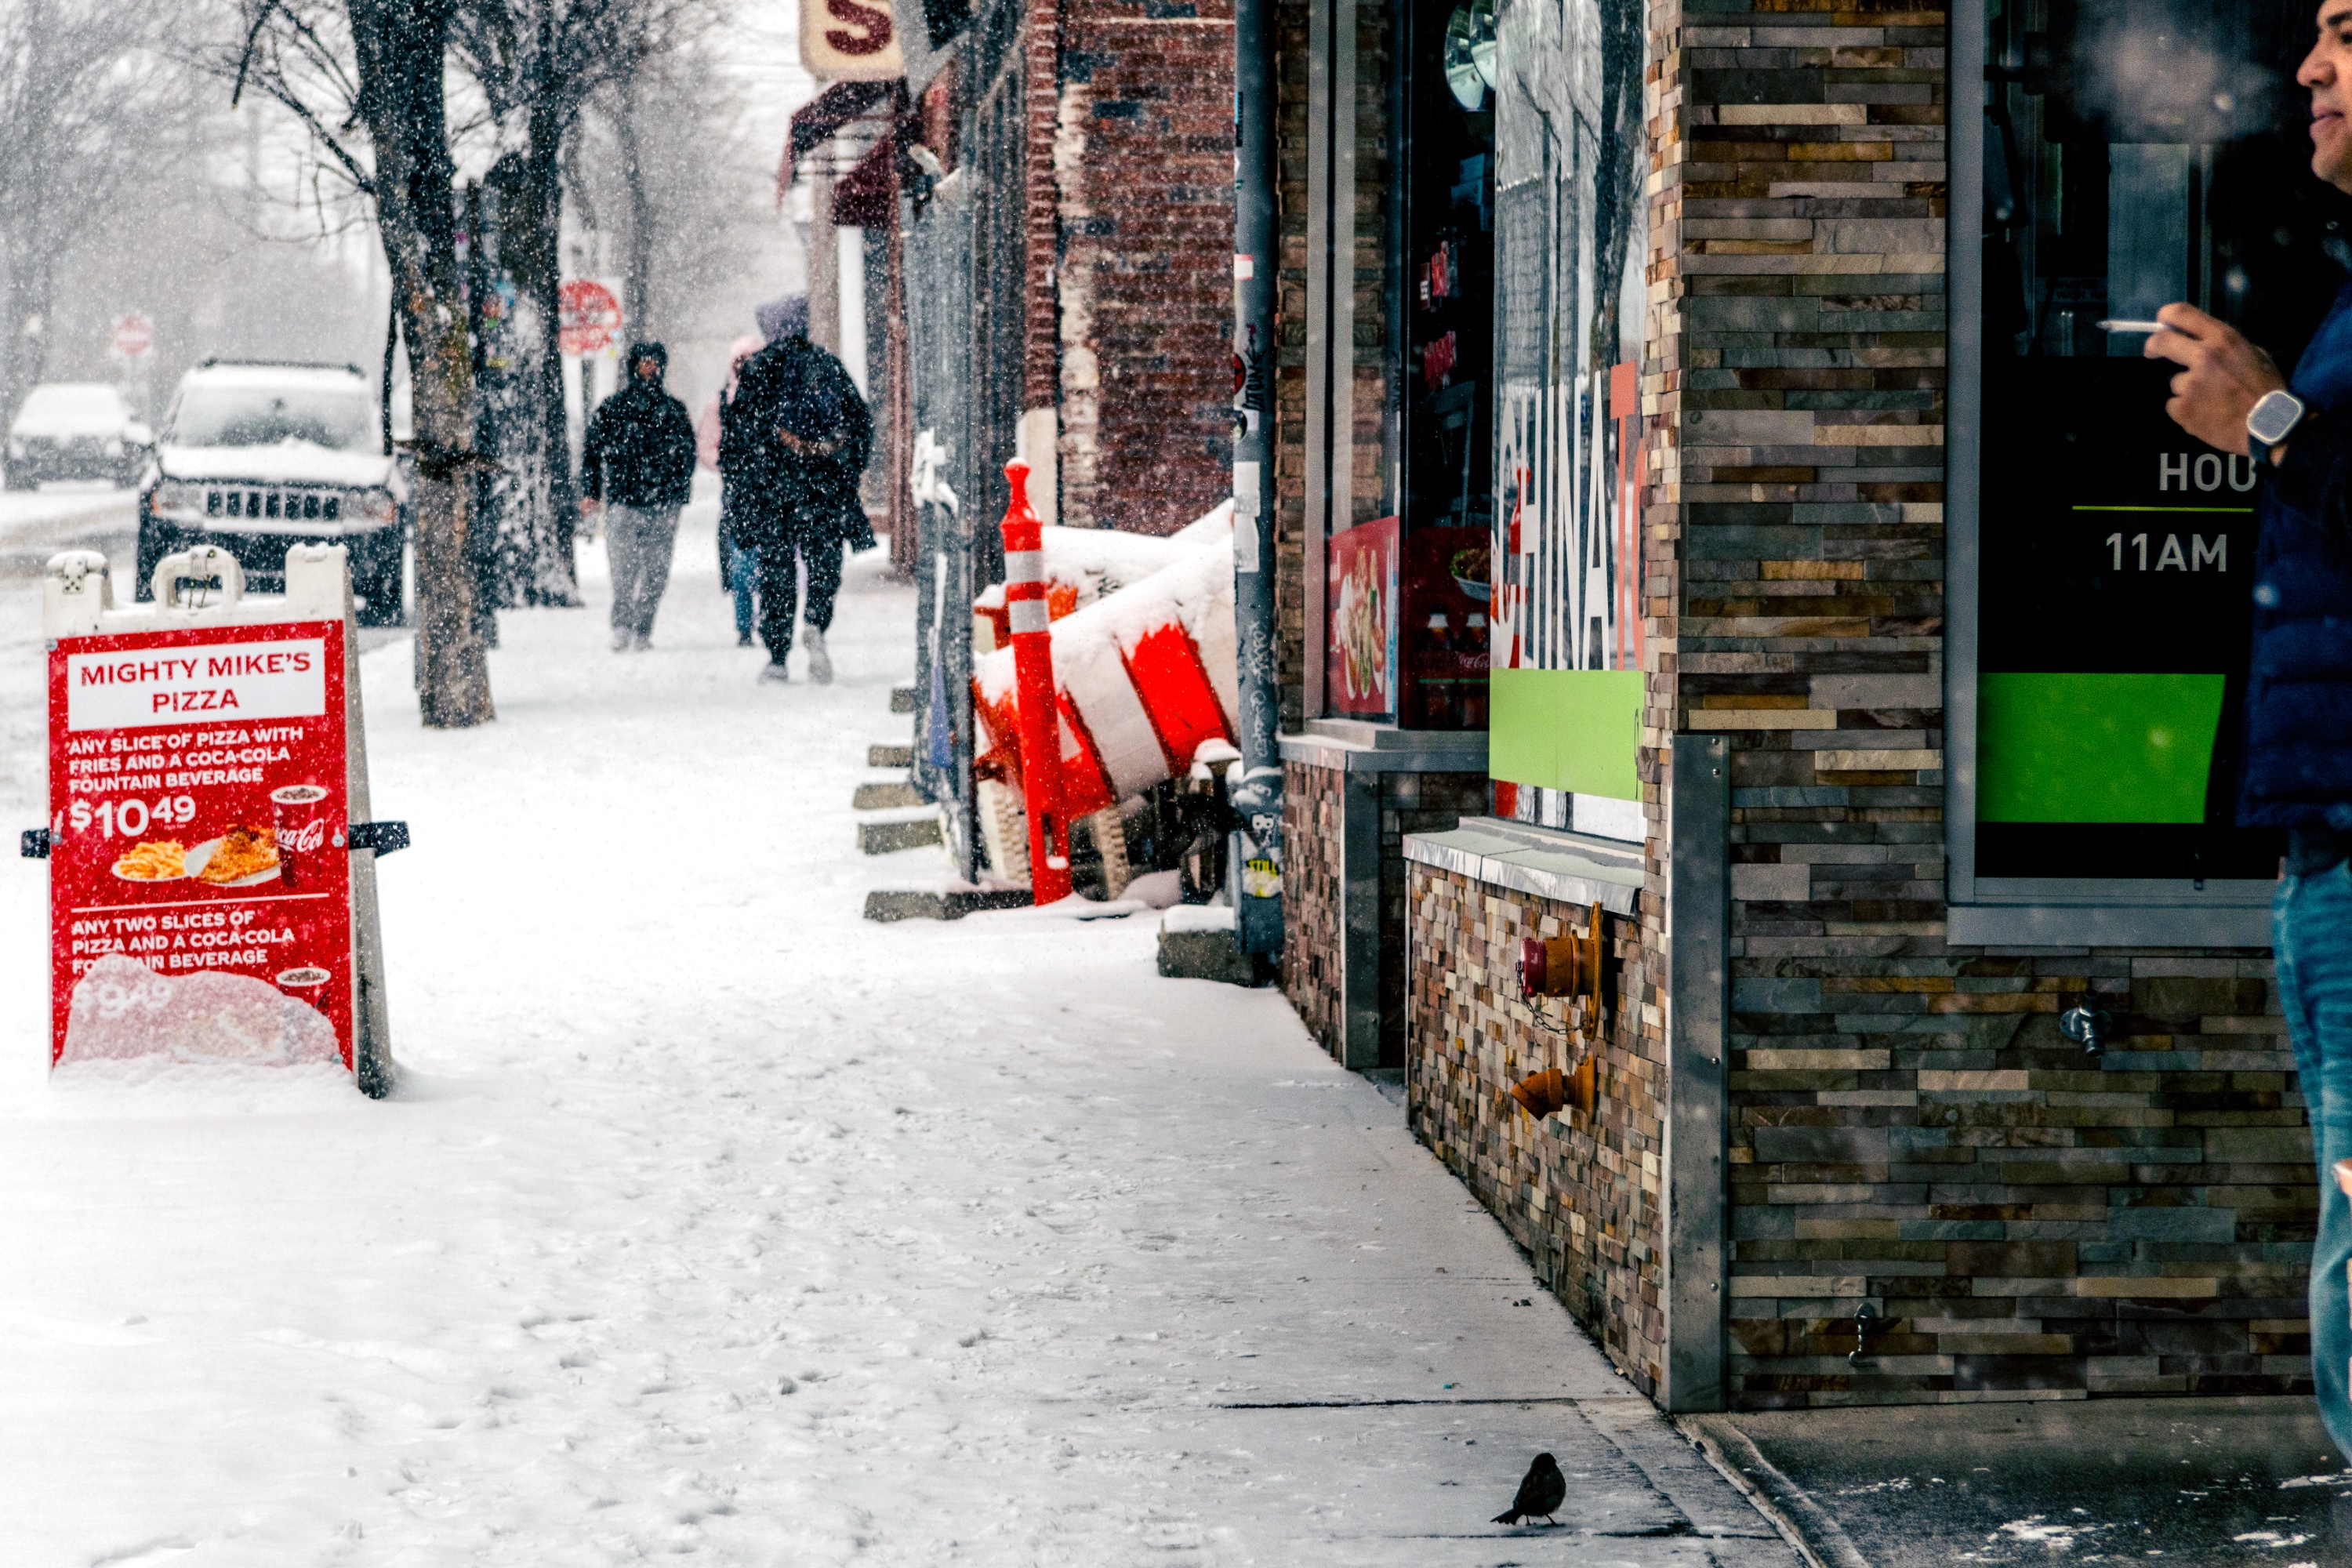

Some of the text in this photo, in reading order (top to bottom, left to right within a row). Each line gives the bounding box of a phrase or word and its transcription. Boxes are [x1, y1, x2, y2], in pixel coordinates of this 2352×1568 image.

[2106, 532, 2227, 572] 11AM
[81, 651, 311, 687] MIGHTY MIKE'S
[152, 688, 241, 713] PIZZA
[68, 726, 303, 756] ANY SLICE OF PIZZA WITH
[69, 757, 122, 775] FRIES
[125, 754, 165, 771] AND
[169, 753, 182, 768] A
[69, 768, 264, 795] FOUNTAIN BEVERAGE
[71, 910, 256, 936] ANY TWO SLICES OF
[72, 937, 125, 956] PIZZA
[129, 935, 169, 953] AND
[172, 933, 187, 949] A
[169, 948, 268, 969] BEVERAGE
